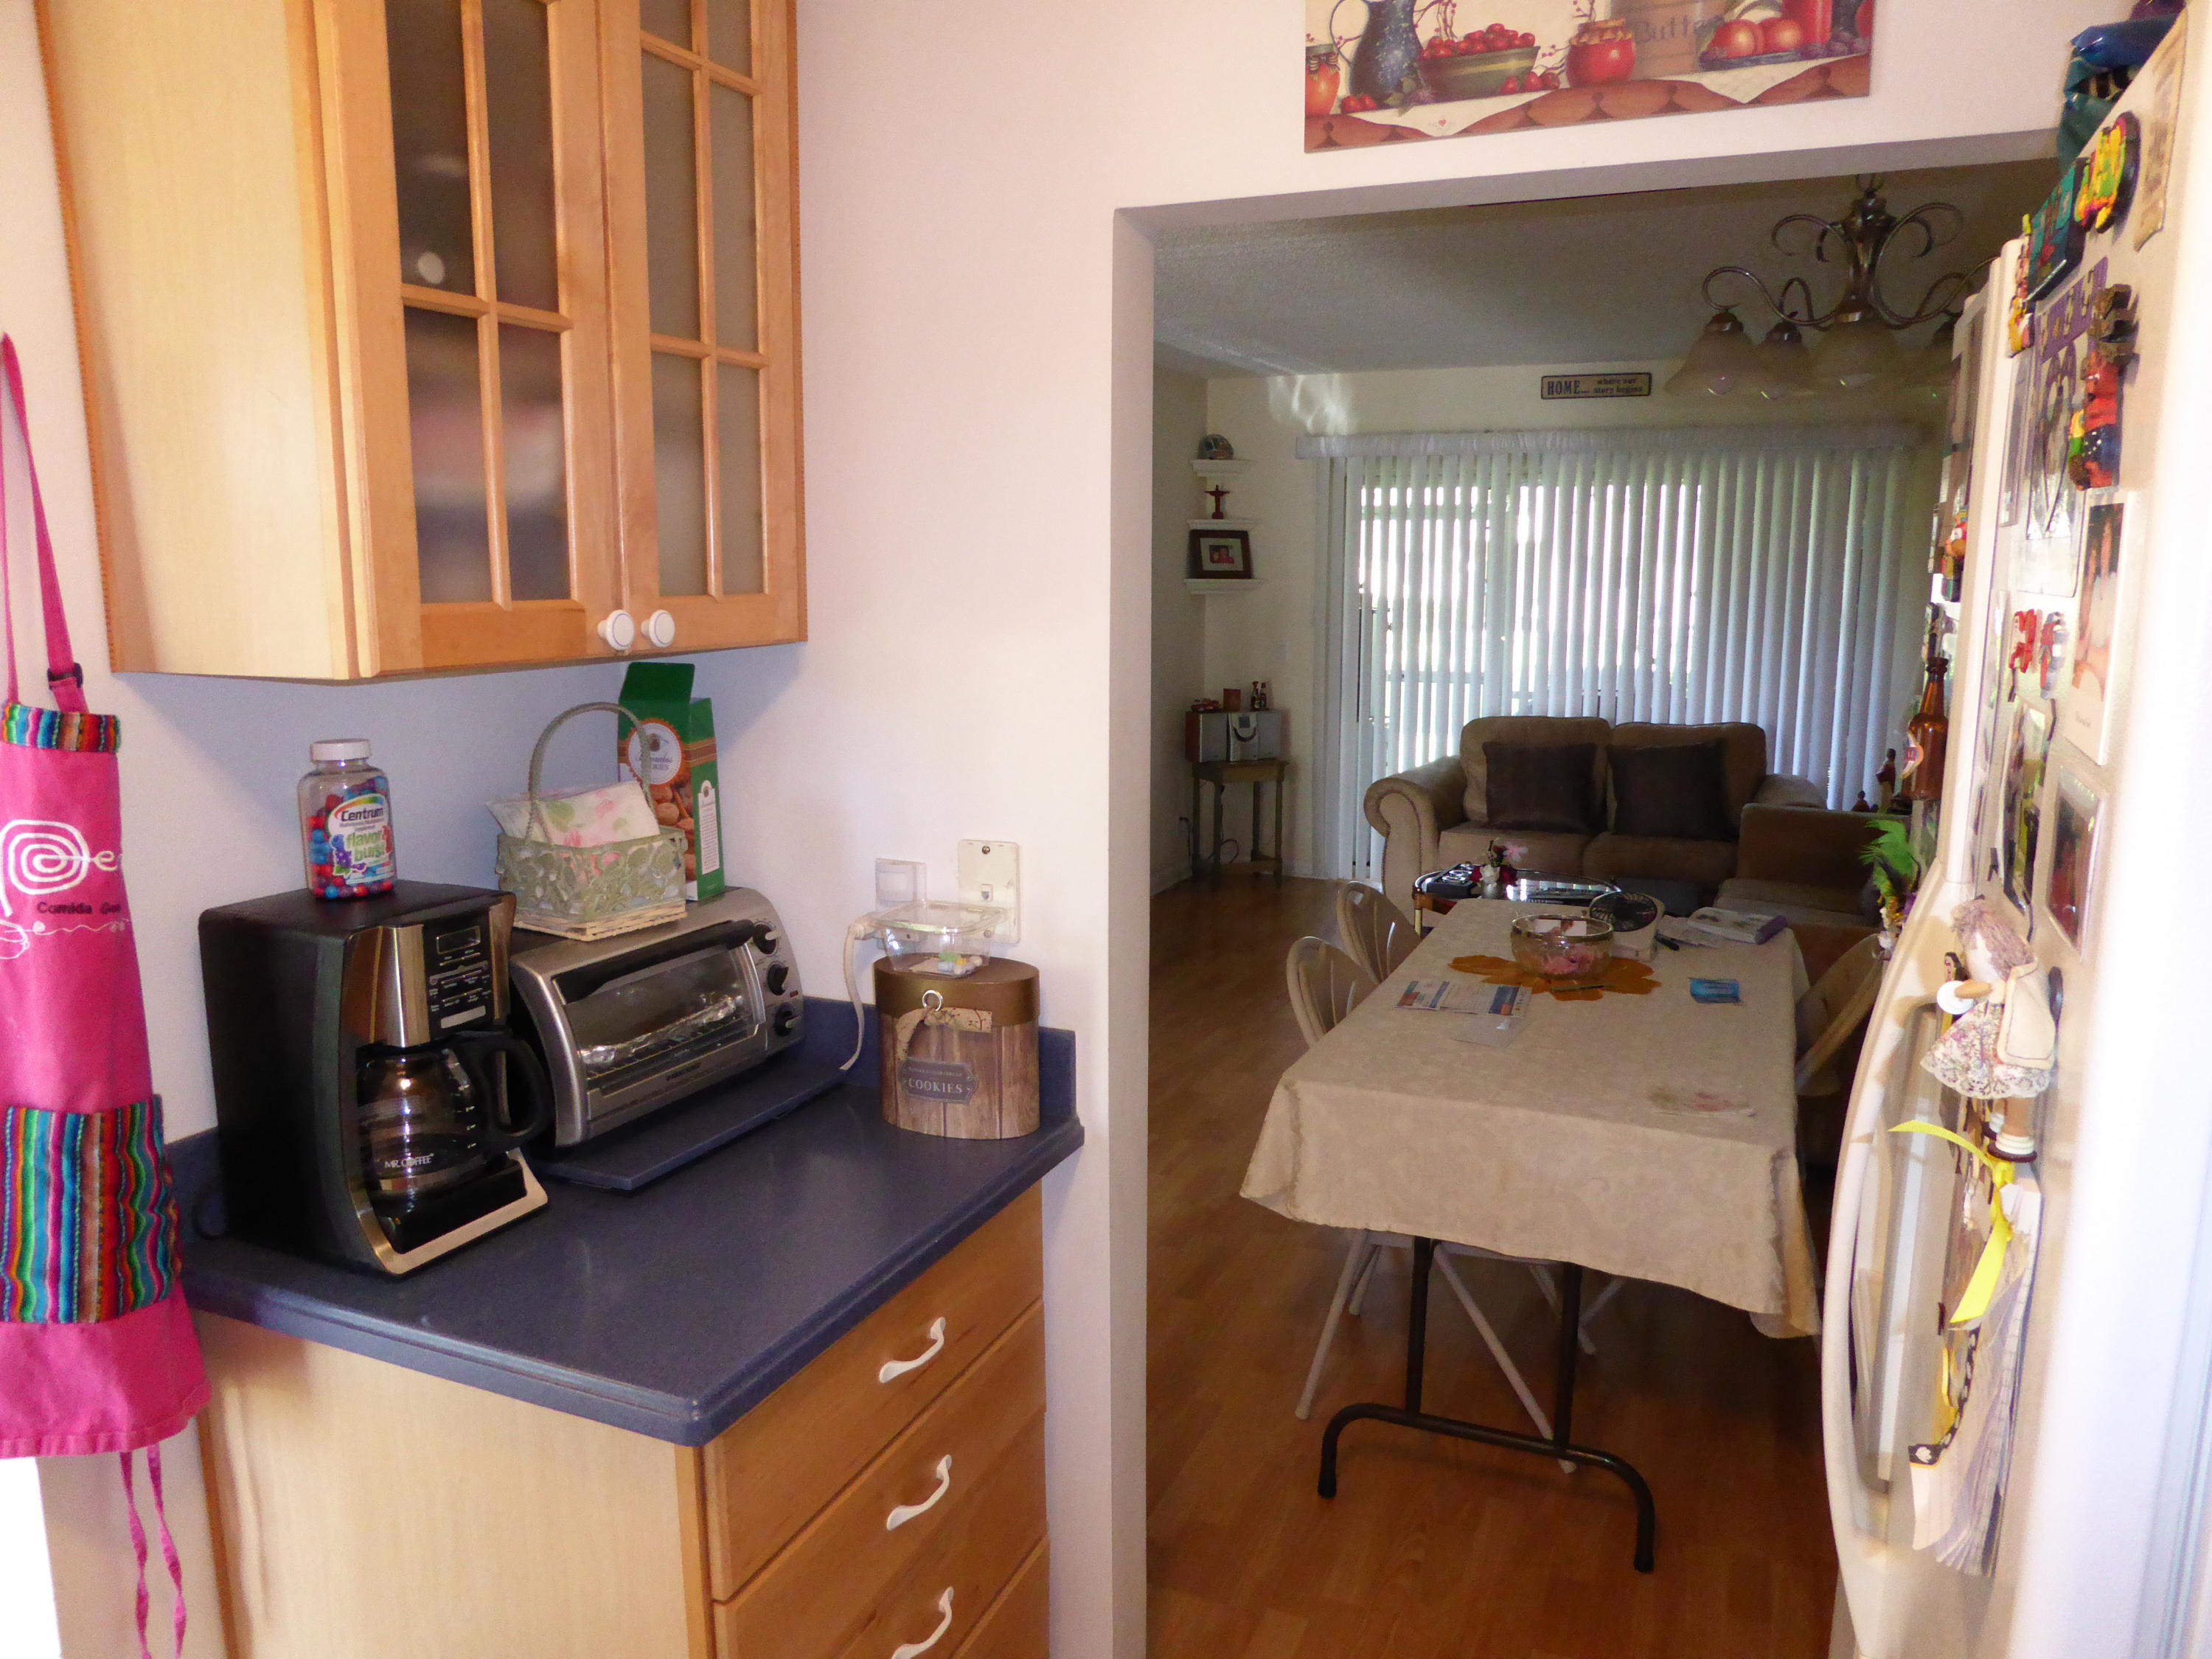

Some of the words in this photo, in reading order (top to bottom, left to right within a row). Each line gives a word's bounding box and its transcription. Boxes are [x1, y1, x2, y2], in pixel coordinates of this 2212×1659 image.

[1616, 385, 1644, 394] begins
[341, 807, 383, 821] Centrum
[908, 1077, 963, 1093] COOKIES
